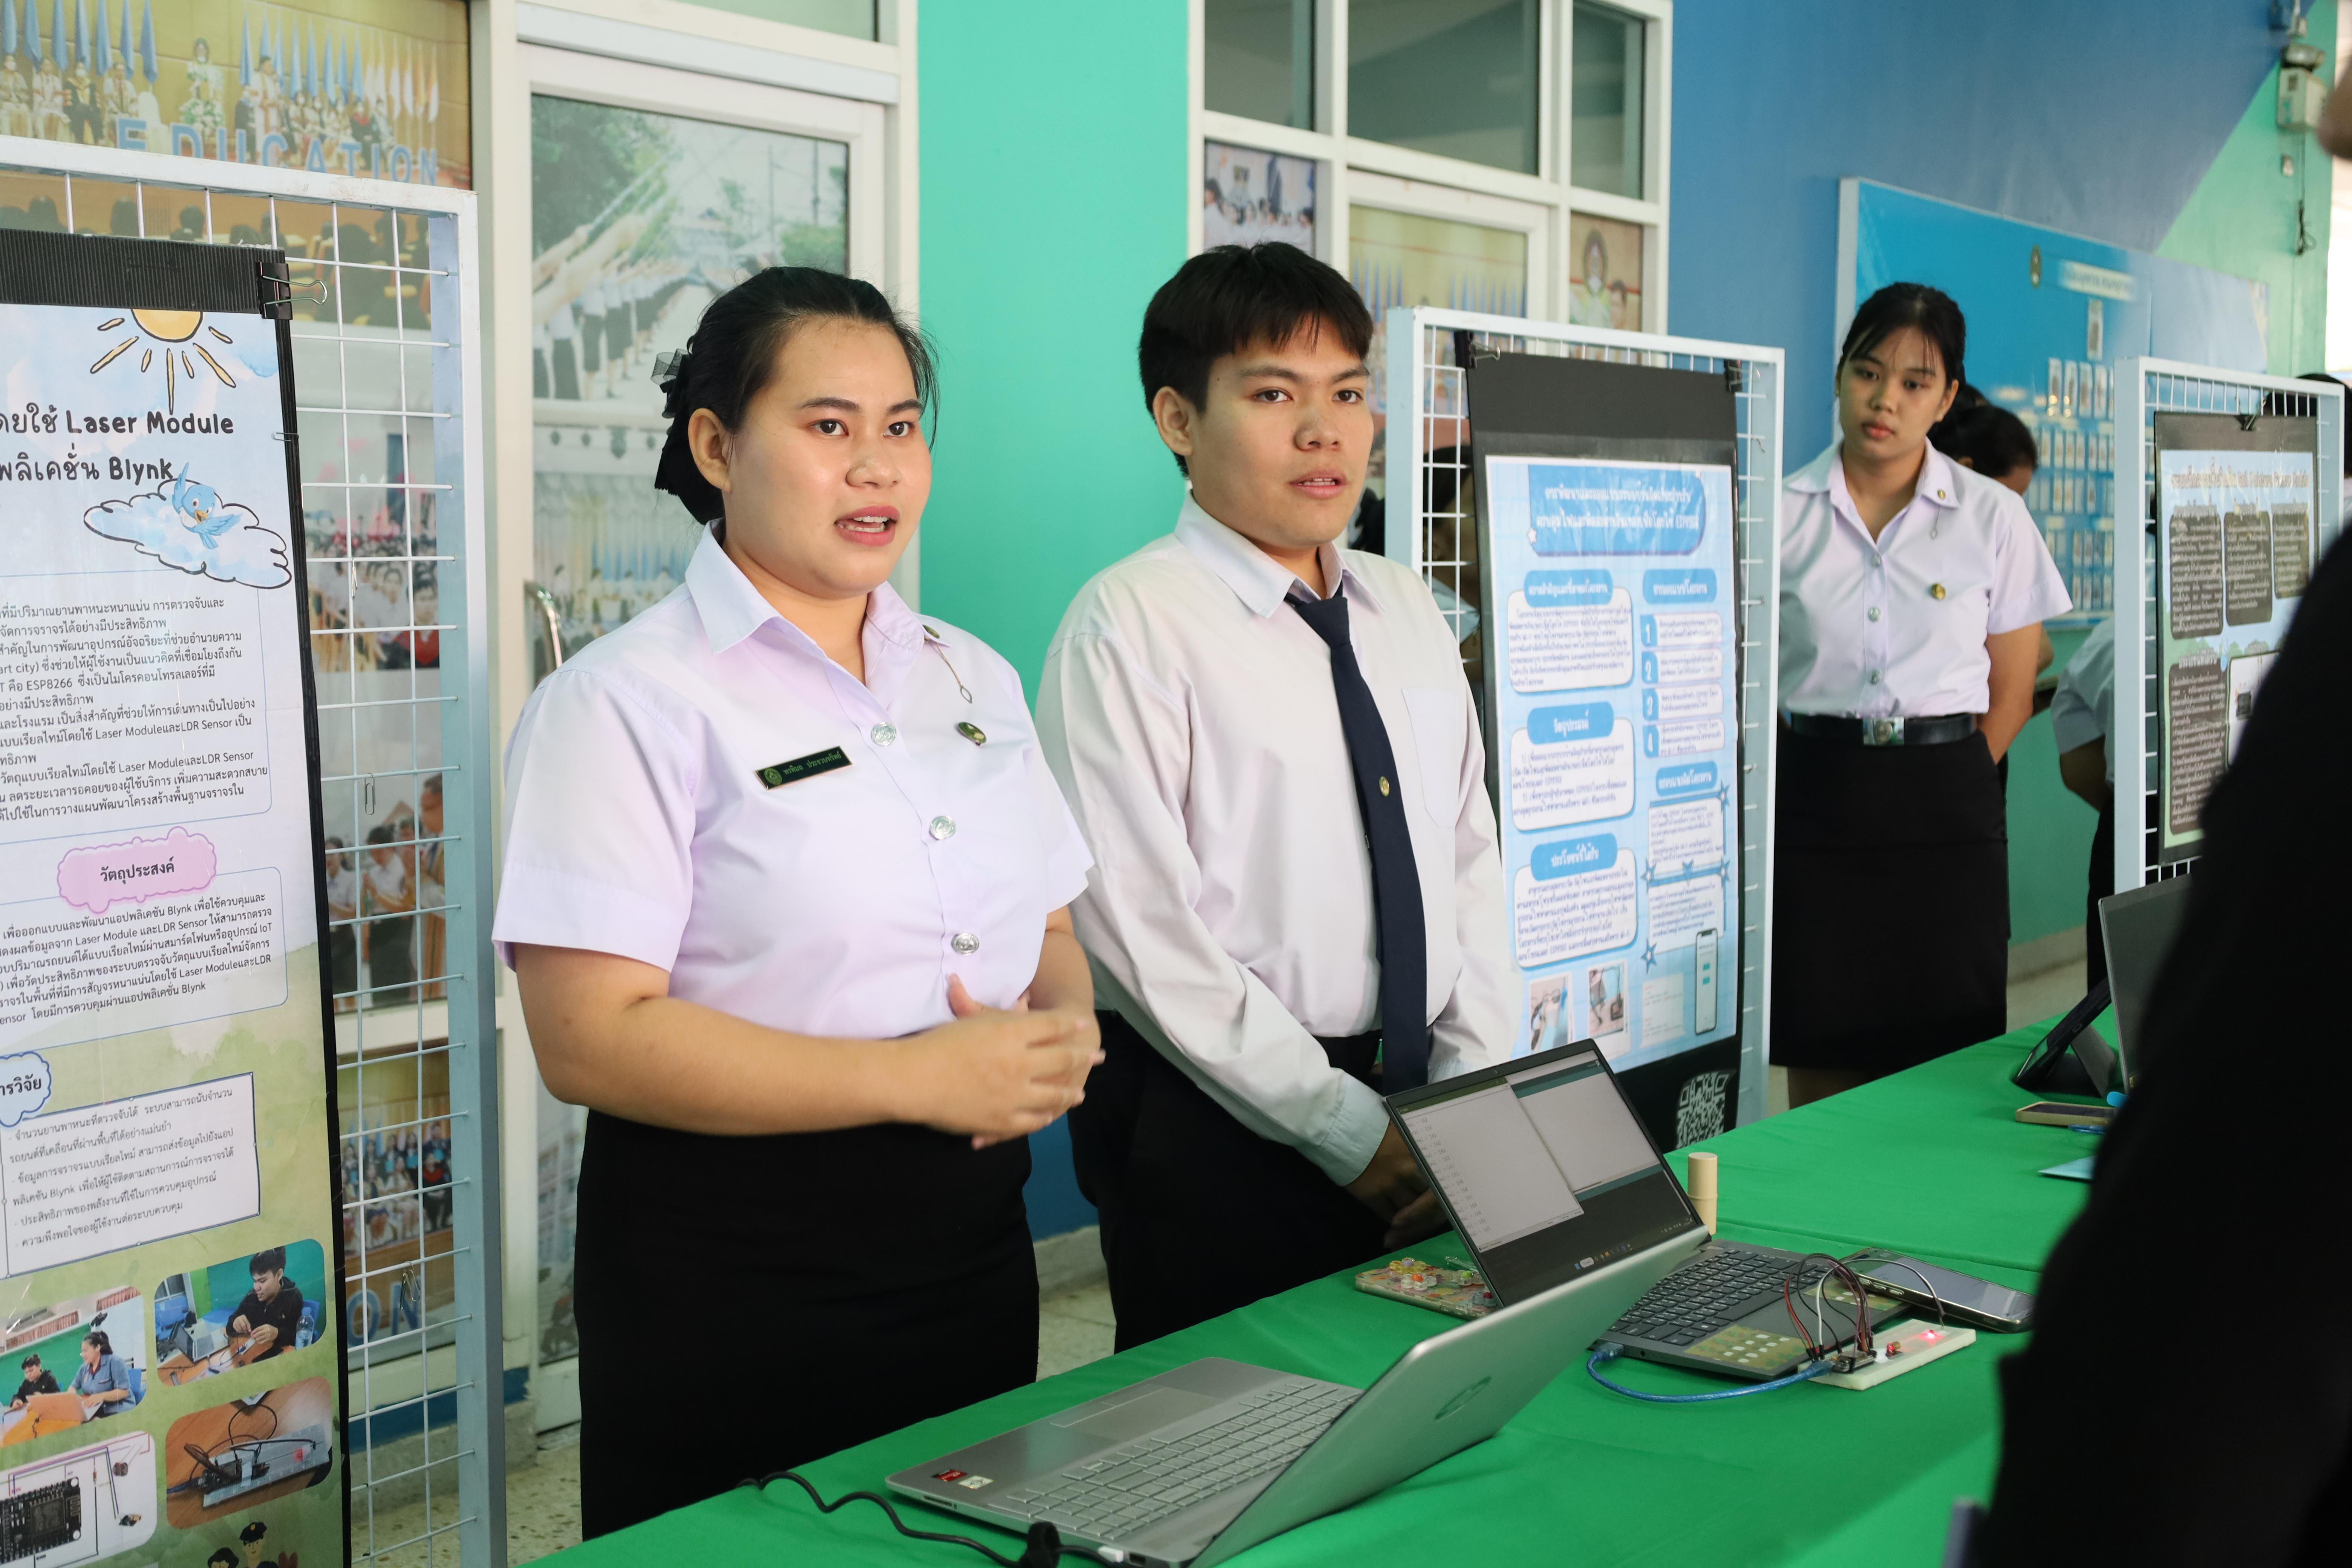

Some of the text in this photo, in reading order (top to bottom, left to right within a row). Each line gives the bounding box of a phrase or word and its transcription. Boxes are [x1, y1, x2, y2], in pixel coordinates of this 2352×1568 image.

[67, 410, 136, 433] Laser
[147, 412, 234, 434] Module
[109, 456, 173, 485] Blynk
[0, 596, 224, 619] ที่มีปริมาณยานพาหนะหนาแน่น การตรวจจับและ
[1645, 623, 1651, 644] 1
[9, 679, 23, 692] คือ
[26, 678, 72, 691] ESP8266
[78, 662, 215, 686] ซึ่งเป็นไมโครคอนโทรลเลอร์ที่มี
[16, 662, 39, 674] city)
[1645, 661, 1652, 681] 2
[0, 694, 93, 711] อย่างมีประสิทธิภาพ
[58, 697, 255, 724] เป็นสิ่งสำคัญที่ช่วยให้การเดินทางเป็นไปอย่าง
[96, 730, 122, 739] Laser
[202, 720, 232, 729] Sensor
[235, 713, 251, 726] เป็น
[119, 763, 145, 773] Laser
[223, 752, 254, 762] Sensor
[9, 775, 171, 802] ลดระยะเวลารอคอยของผู้ใช้บริการ
[174, 767, 267, 784] เพิ่มความสะดวกสบาย
[100, 856, 174, 885] วัตถุประสงค์
[168, 903, 192, 916] Blynk
[194, 894, 265, 911] เพื่อใช้ควบคุมและ
[0, 908, 272, 957] ดงผลข้อมูลจาก Laser Module และLDR Sensor ให้สามารถตรวจ
[260, 922, 272, 933] IoT
[179, 968, 203, 978] Laser
[182, 981, 206, 994] Blynk
[15, 1090, 232, 1140] จำนวนยานพาหนะที่ตรวจจับได้ ระบบสามารถนับจำนวน
[18, 1127, 233, 1184] ข้อมูลการจราจรแบบเรียลไทม์ สามารถส่งข้อมูลไปยังแอป
[50, 1186, 75, 1198] Blynk
